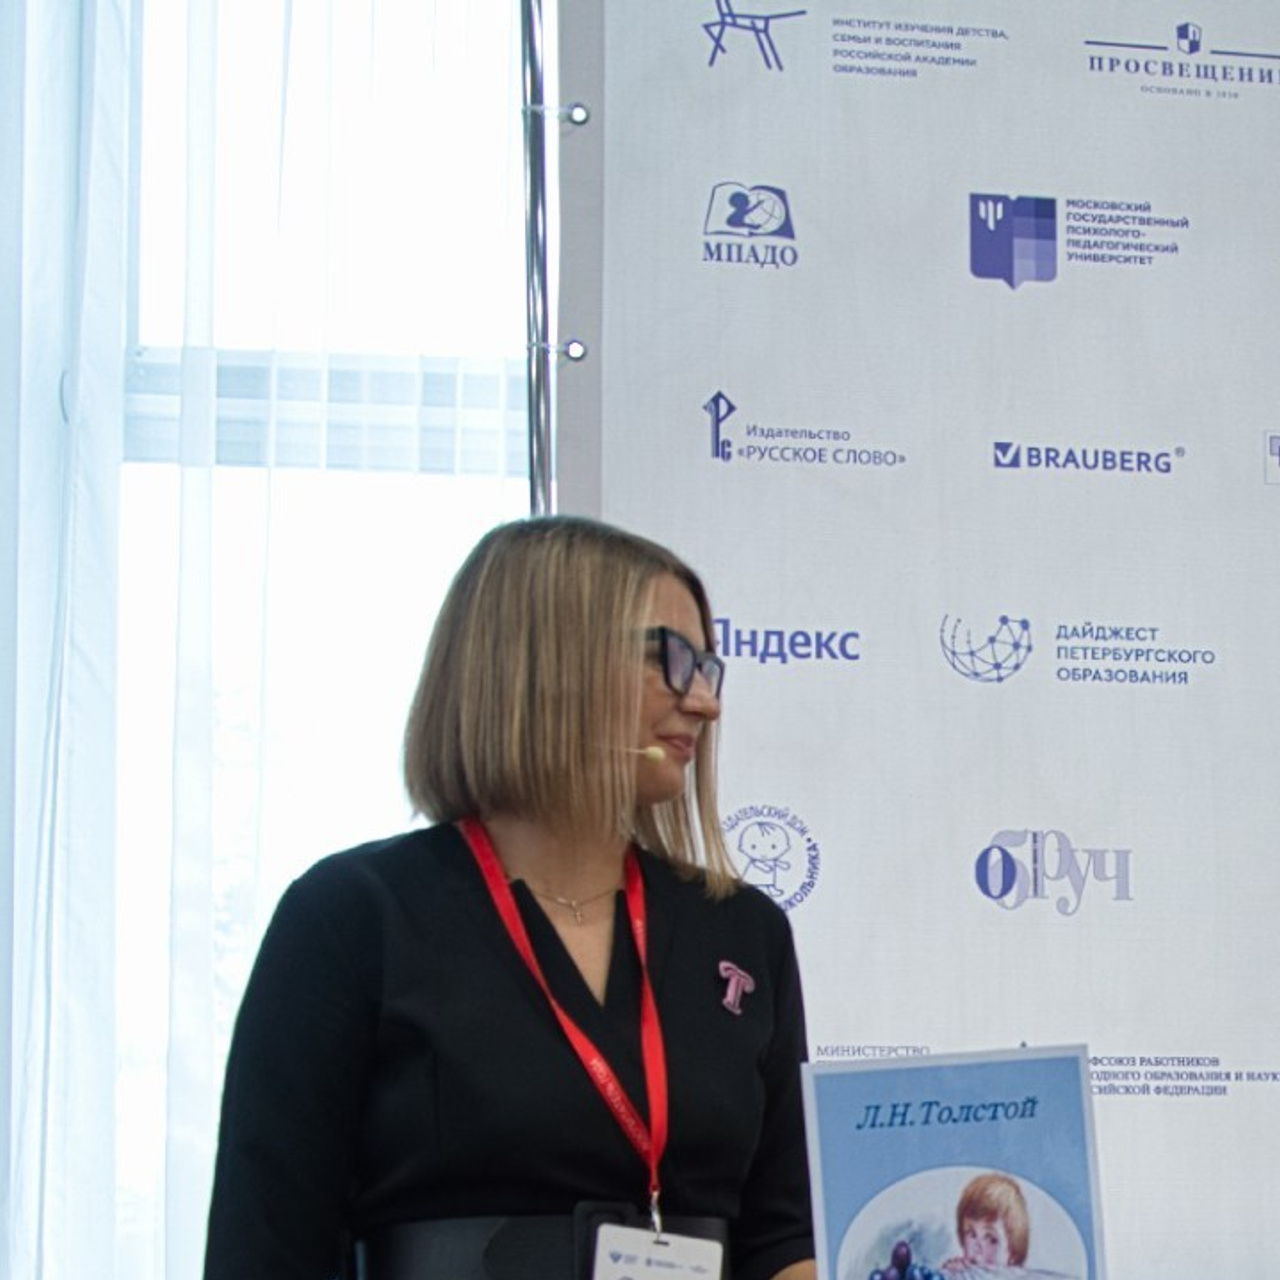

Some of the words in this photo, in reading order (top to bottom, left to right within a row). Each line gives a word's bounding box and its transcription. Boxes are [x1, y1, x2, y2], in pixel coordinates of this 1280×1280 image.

[1066, 199, 1152, 213] МОСКОВСКИЙ
[1066, 211, 1189, 228] ГОСУДАРСТВЕННЫЙ
[1066, 238, 1179, 254] ПЕДАГОГИЧЕСКИЙ
[702, 241, 798, 269] МПАДО
[1066, 251, 1154, 265] УНИВЕРСИТЕТ
[745, 424, 851, 443] Издательство
[737, 444, 828, 464] «РУССКОЕ
[832, 448, 906, 467] СЛОВО»
[1056, 621, 1159, 644] ДАЙДЖЕСТ
[1056, 645, 1216, 666] ПЕТЕРБУРГСКОГО
[1056, 667, 1189, 686] ОБРАЗОВАНИЯ
[816, 1045, 930, 1058] МИНИСТЕРСТВО
[1089, 1056, 1136, 1067] ФСОЮЗ
[1139, 1057, 1220, 1067] РАБОТНИКОВ
[1091, 1071, 1141, 1082] ОДНОГО
[1144, 1071, 1231, 1082] ОБРАЗОВАНИЯ
[1091, 1084, 1150, 1096] СИЙСКОЙ
[1153, 1086, 1228, 1097] ФЕДЕРАЦИИ
[856, 1096, 1039, 1131] Л.Н.Толстой
